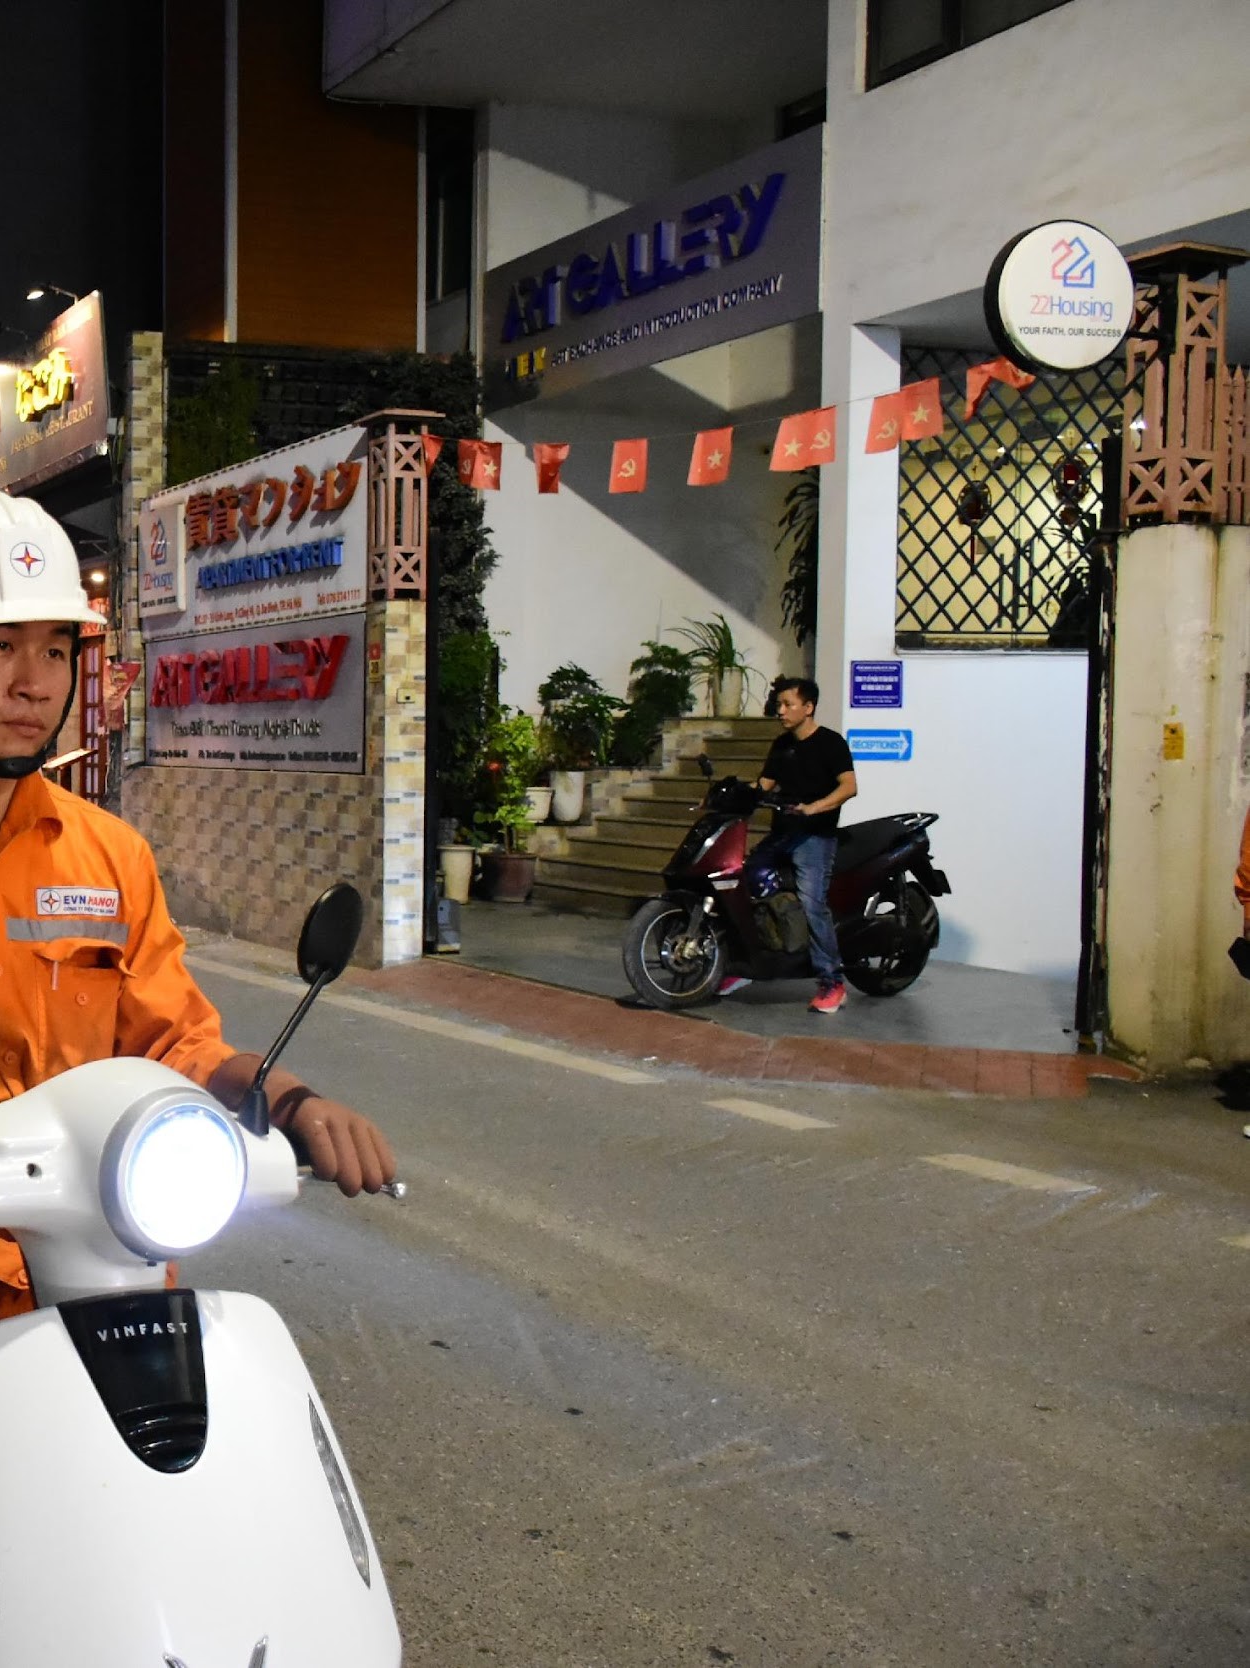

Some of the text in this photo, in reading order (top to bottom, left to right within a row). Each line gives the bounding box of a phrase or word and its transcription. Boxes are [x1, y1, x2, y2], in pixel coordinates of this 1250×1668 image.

[566, 172, 787, 315] GALLERY
[641, 295, 721, 336] INTRODUCTION
[722, 272, 783, 309] COMPANY
[1030, 295, 1113, 323] 22Housing
[1019, 326, 1040, 335] YOUR
[1068, 328, 1084, 336] OUR
[1086, 328, 1122, 338] SUCCESS
[852, 739, 904, 749] RECEPTIONIST
[63, 895, 86, 905] EVN
[97, 1322, 188, 1342] VINFAST
